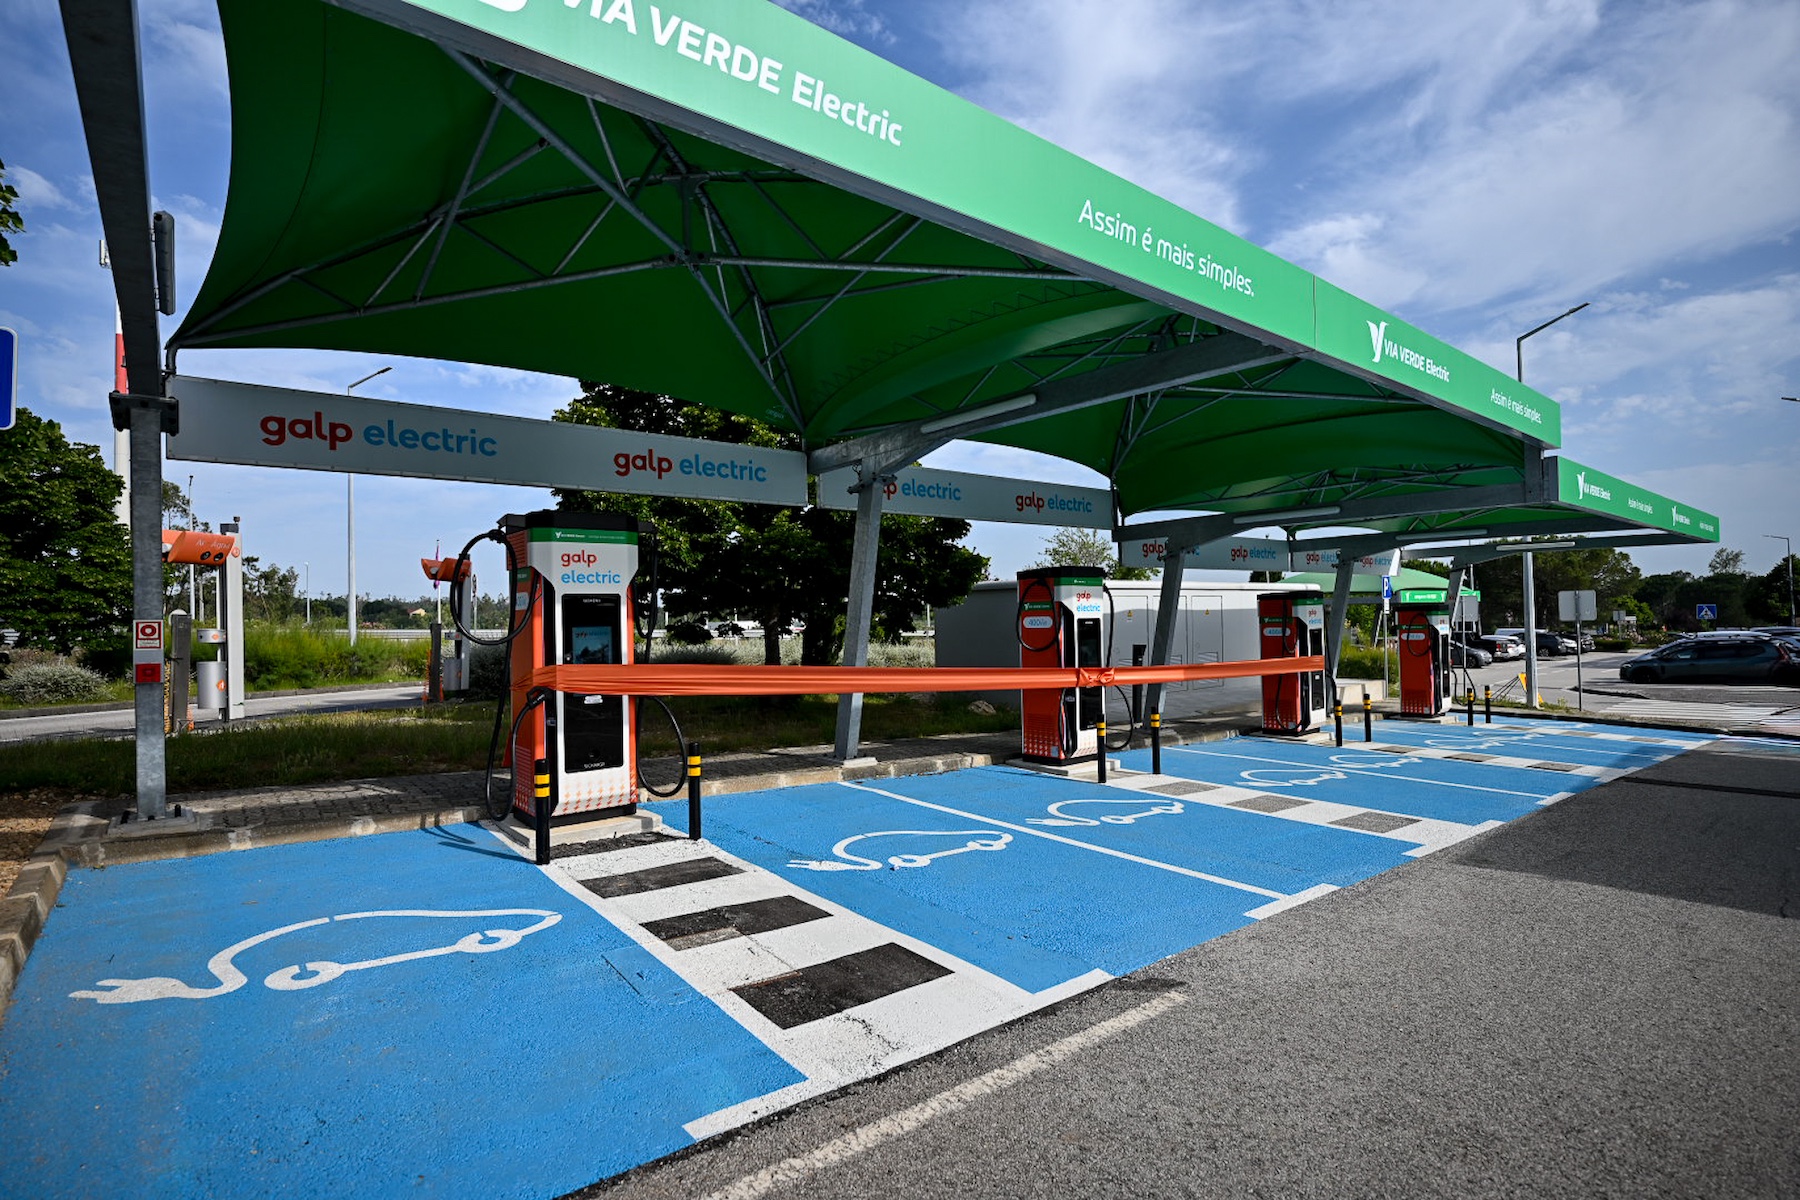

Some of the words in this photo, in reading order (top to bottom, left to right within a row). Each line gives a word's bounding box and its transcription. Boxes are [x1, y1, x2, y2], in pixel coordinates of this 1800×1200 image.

[563, 0, 637, 35] IA
[650, 5, 783, 95] VERDE
[791, 71, 902, 146] Electric
[1078, 199, 1137, 246] Assim
[1141, 227, 1152, 252] é
[1156, 239, 1194, 270] mais
[1198, 254, 1255, 297] simples.
[1384, 338, 1399, 360] VIA
[1399, 346, 1425, 371] VERDE
[1426, 358, 1449, 382] Electric
[1491, 388, 1507, 407] Assim
[259, 411, 352, 450] galp
[363, 420, 498, 457] electric
[613, 449, 673, 480] galp
[679, 454, 767, 482] electric
[901, 479, 961, 501] electric
[1015, 492, 1045, 513] galp
[1047, 494, 1092, 513] electric
[561, 549, 597, 568] galp
[1142, 540, 1164, 558] galp
[1230, 545, 1248, 561] galp
[1249, 547, 1276, 560] electric
[1306, 552, 1319, 565] galp
[561, 570, 621, 584] electric
[1076, 590, 1092, 602] galp
[1383, 577, 1389, 597] P
[1076, 604, 1101, 612] electric
